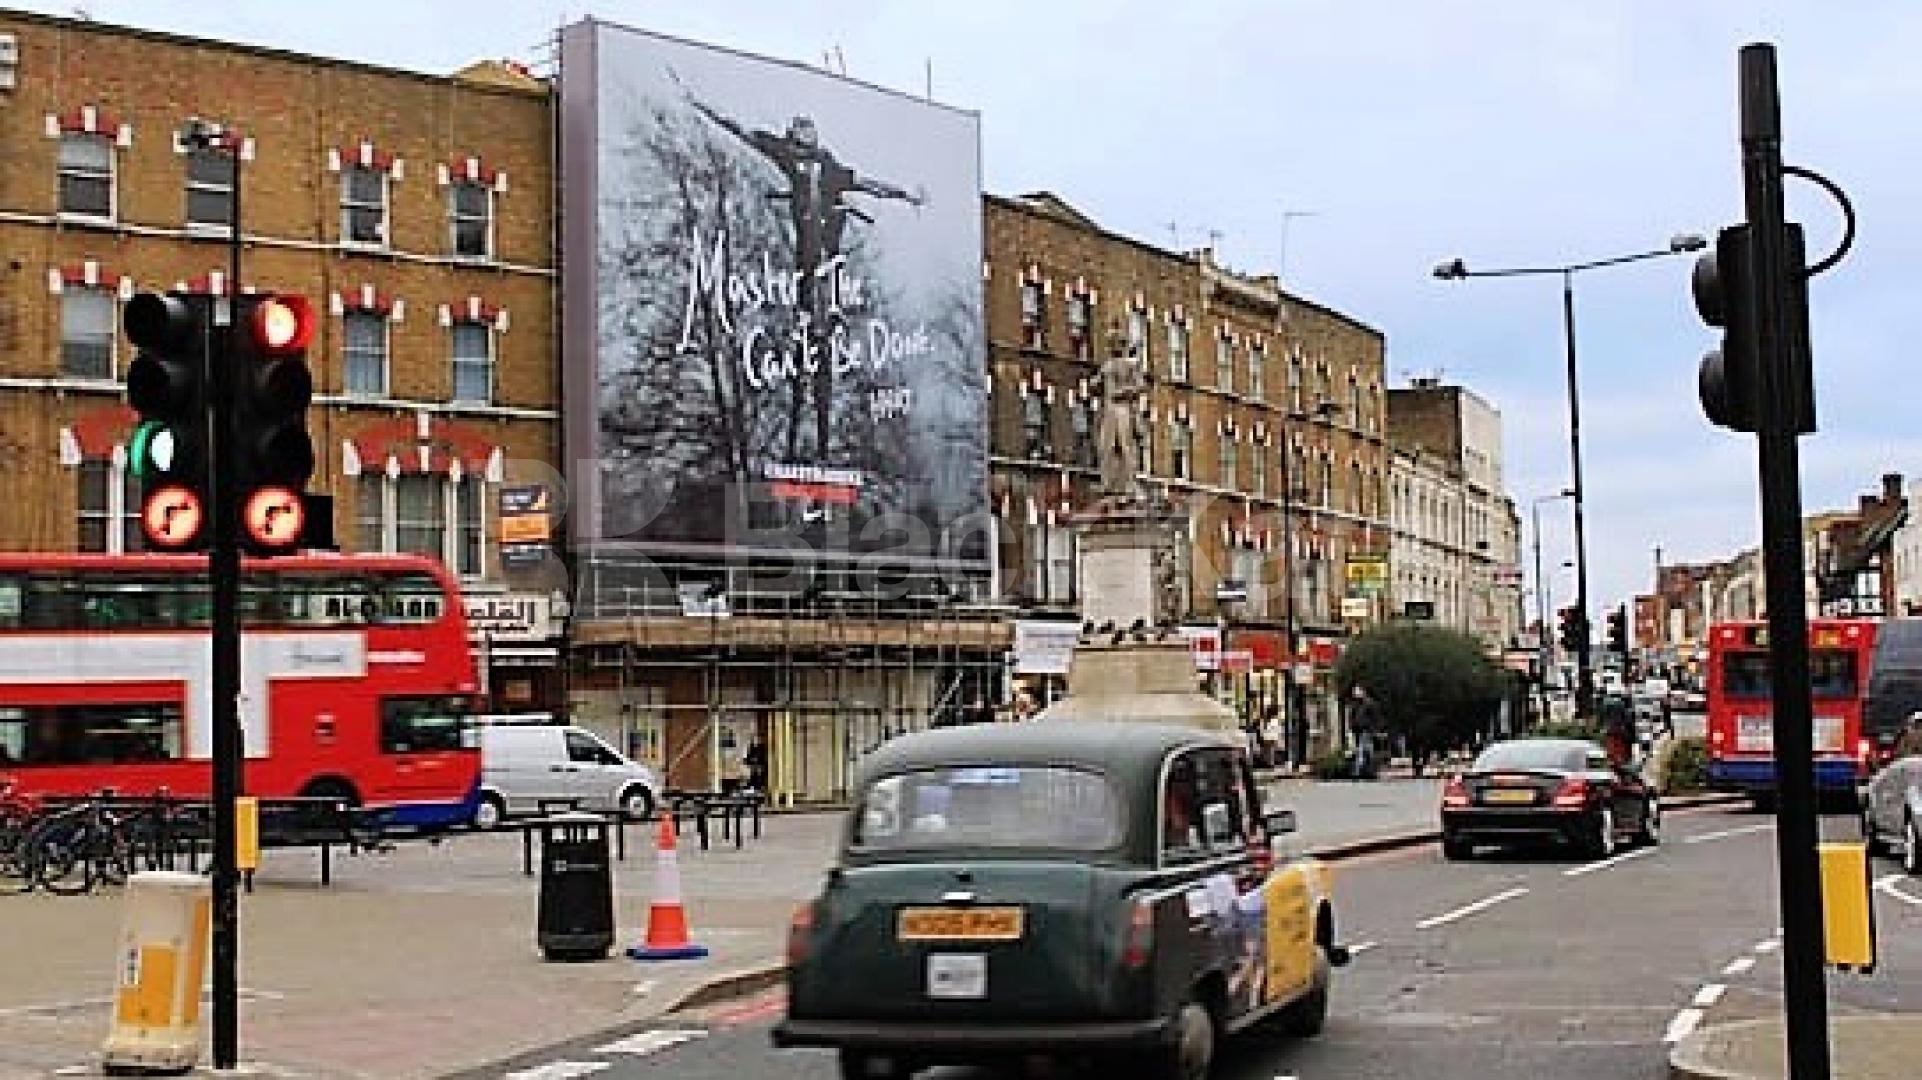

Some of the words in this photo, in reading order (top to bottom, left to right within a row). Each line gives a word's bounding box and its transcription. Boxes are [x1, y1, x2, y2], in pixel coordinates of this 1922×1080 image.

[676, 226, 803, 354] Master
[814, 254, 863, 312] The
[743, 310, 818, 387] Can't
[831, 325, 861, 373] Be
